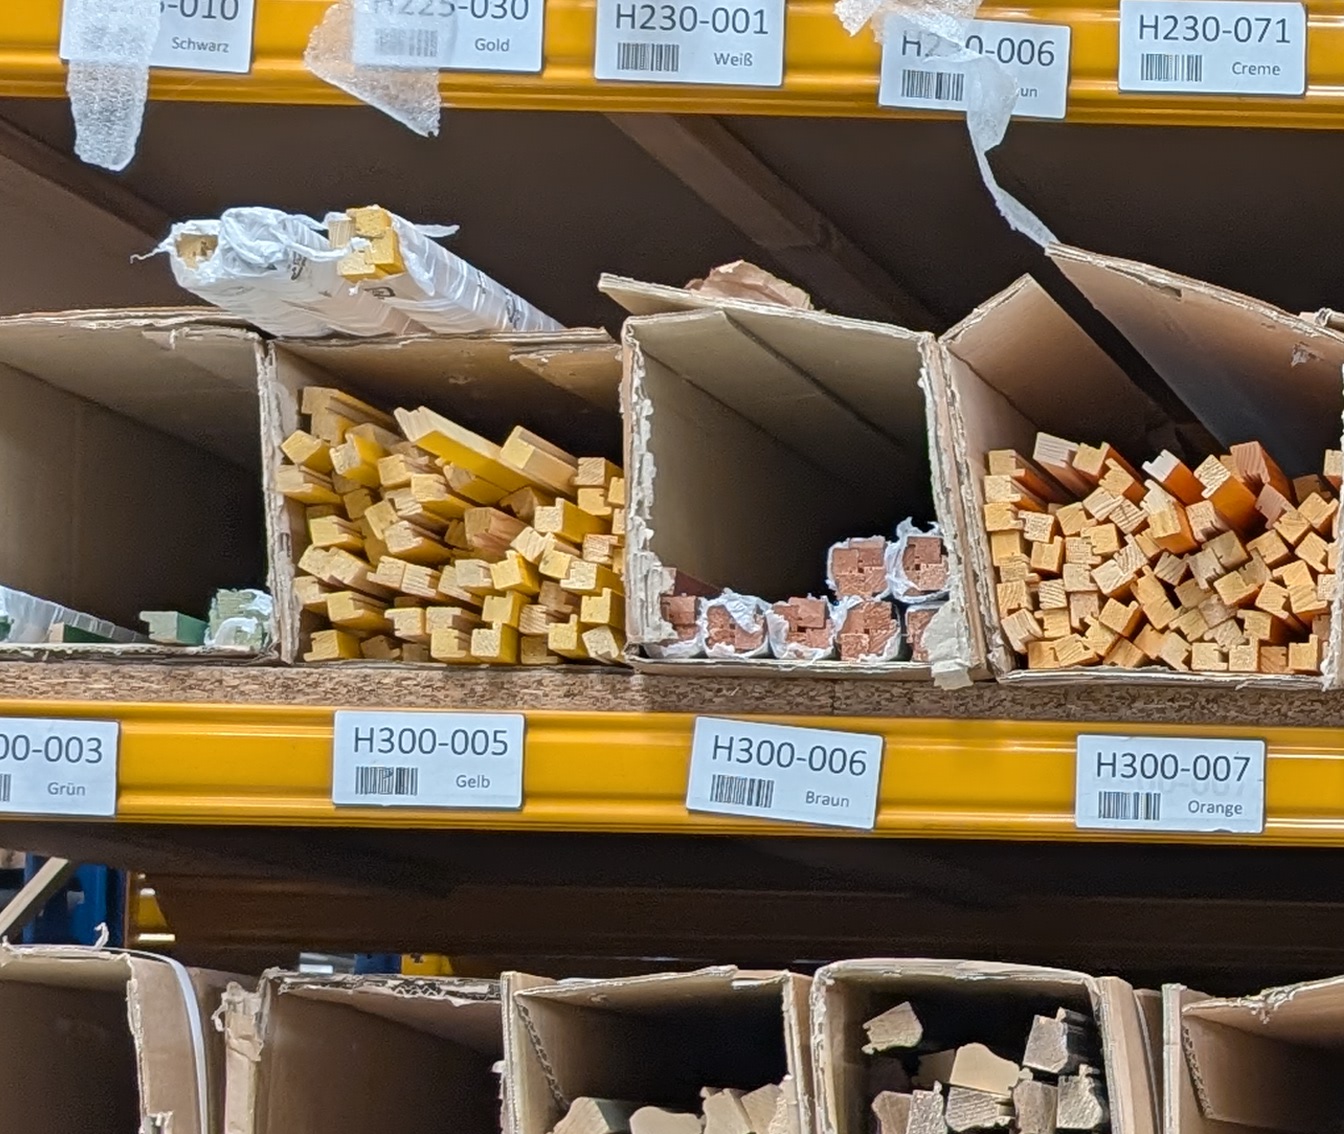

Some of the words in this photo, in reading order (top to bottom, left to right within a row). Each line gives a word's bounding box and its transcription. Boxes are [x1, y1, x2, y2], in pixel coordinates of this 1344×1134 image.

[615, 3, 769, 35] H230-001
[1139, 14, 1291, 44] H230-071
[171, 36, 230, 54] Schwarz
[474, 37, 511, 53] Gold
[901, 31, 1056, 67] H20-006
[713, 52, 753, 67] Weiß
[1231, 61, 1281, 76] Creme
[353, 726, 508, 756] H300-005
[712, 735, 868, 777] H300-006
[1096, 751, 1251, 782] H300-007
[47, 781, 86, 797] Grün
[455, 774, 491, 789] Gelb
[805, 790, 850, 808] Braun
[1187, 799, 1243, 818] Orange
